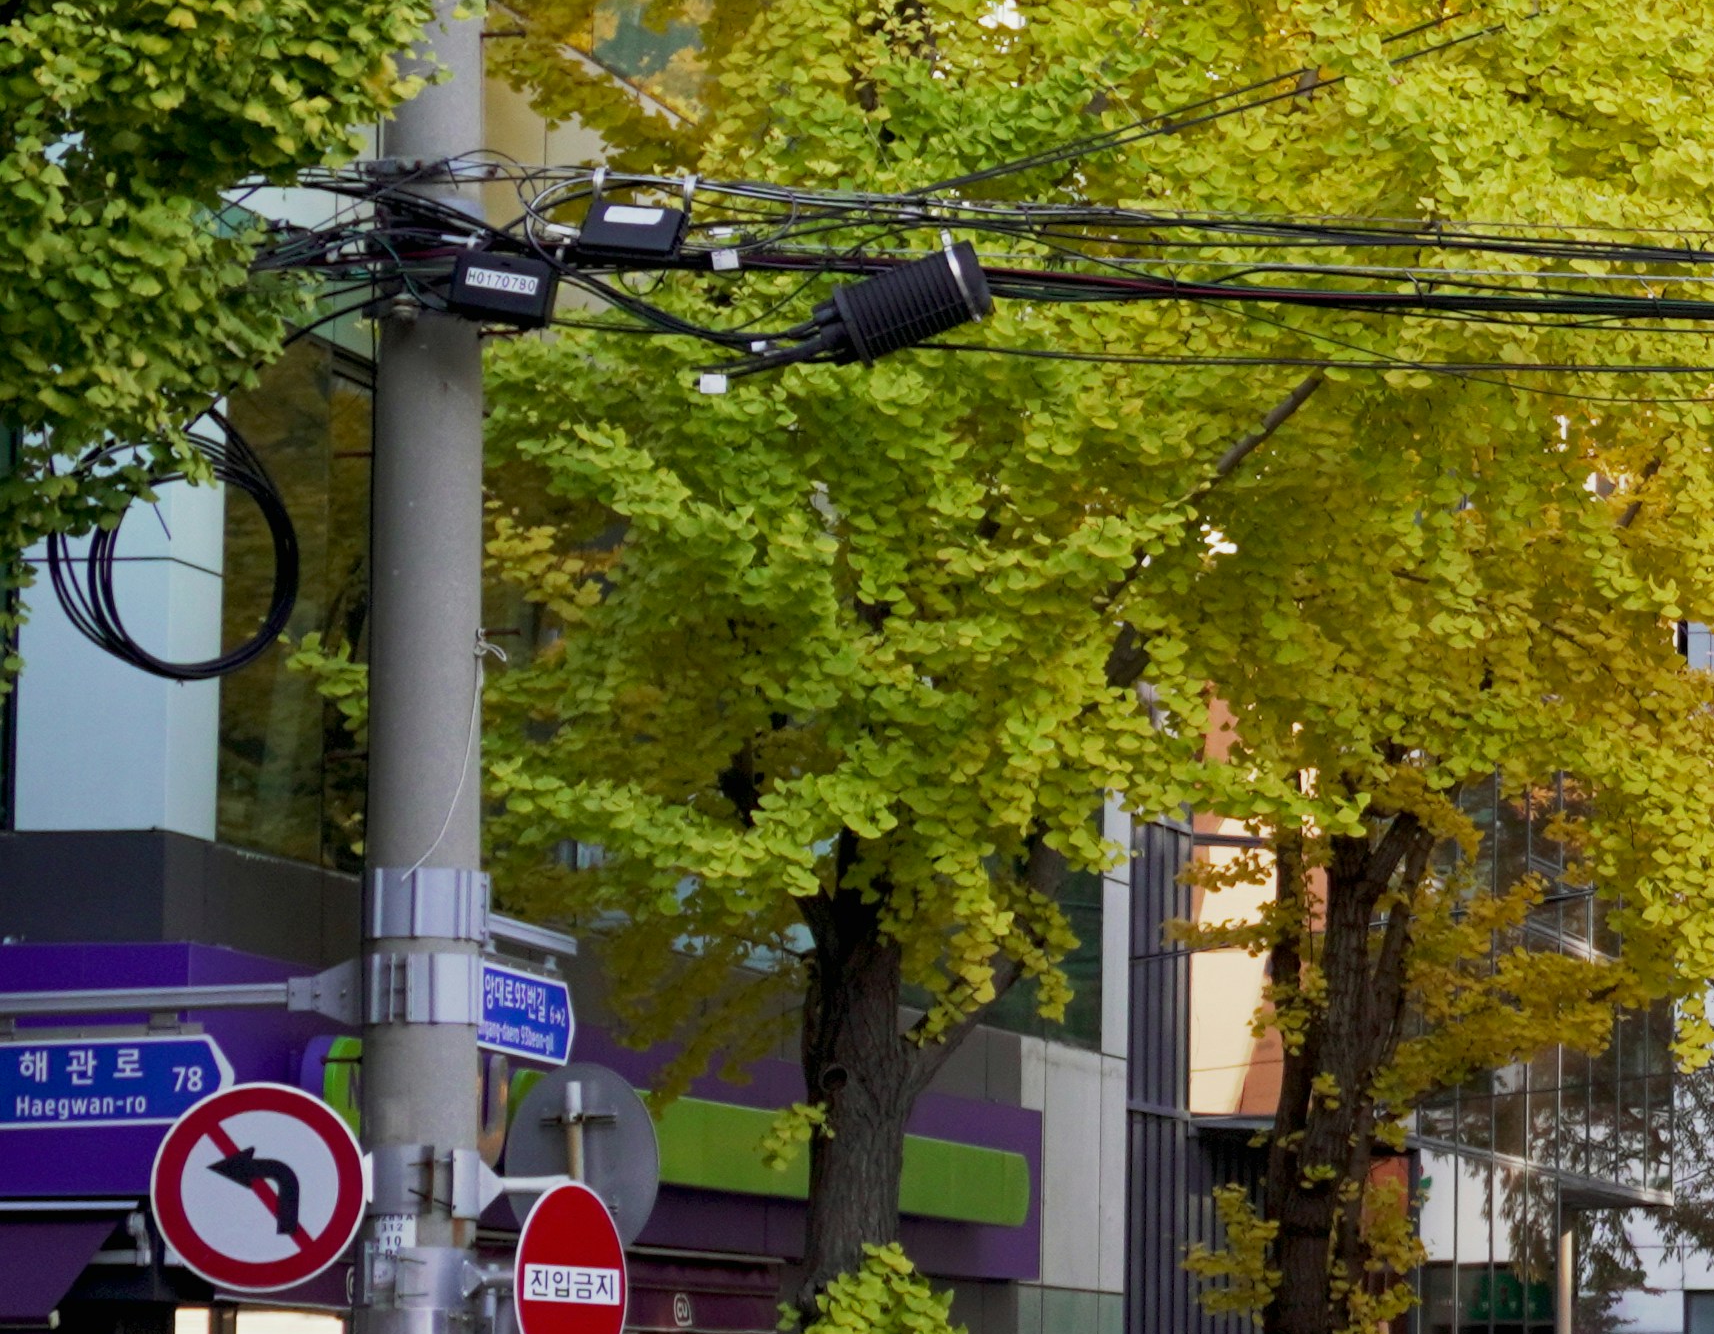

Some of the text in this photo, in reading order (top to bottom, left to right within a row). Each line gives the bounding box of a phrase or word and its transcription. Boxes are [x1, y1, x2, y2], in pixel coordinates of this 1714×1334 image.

[485, 974, 546, 1023] 앙대로93번길
[19, 1049, 203, 1093] 해관로 78
[15, 1094, 147, 1120] Haegwan-ro
[531, 1269, 614, 1300] 진입금지
